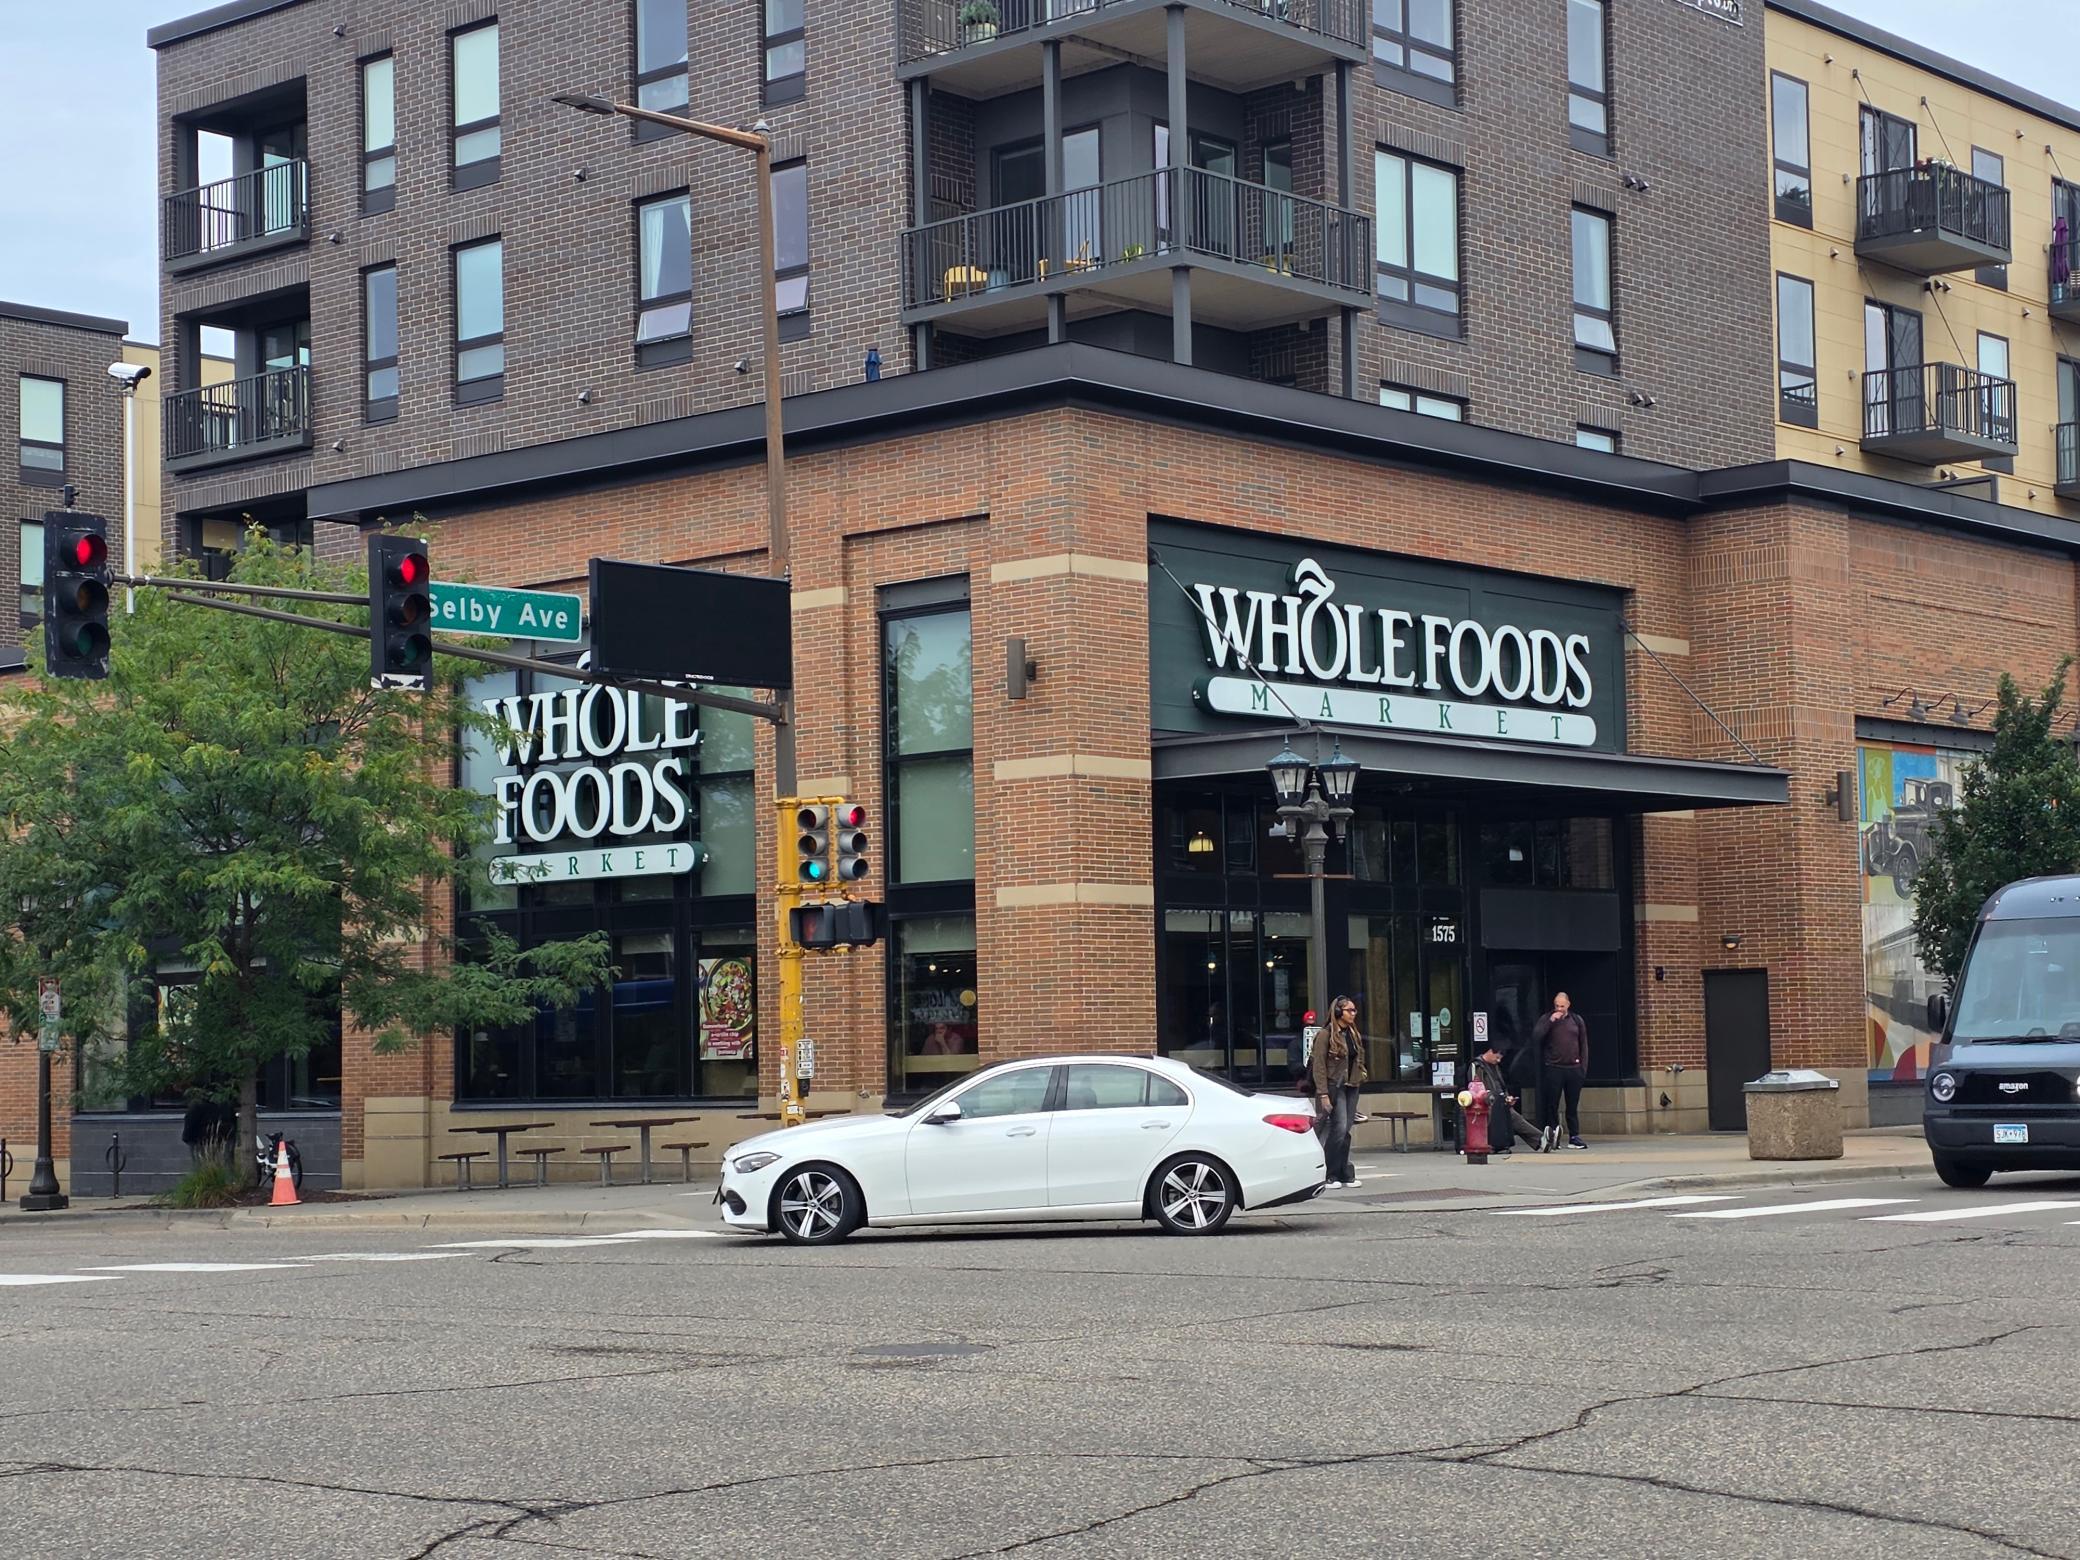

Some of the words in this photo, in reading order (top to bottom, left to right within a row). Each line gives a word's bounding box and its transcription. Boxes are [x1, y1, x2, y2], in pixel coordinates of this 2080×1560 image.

[429, 593, 502, 629] Selby
[518, 602, 568, 629] Ave
[1194, 558, 1413, 683] WHOLE
[1421, 613, 1593, 709] FOODS
[1251, 683, 1563, 740] MARKET
[492, 757, 686, 845] FOODS
[1432, 925, 1455, 942] 1575
[1999, 1082, 2029, 1092] amazon
